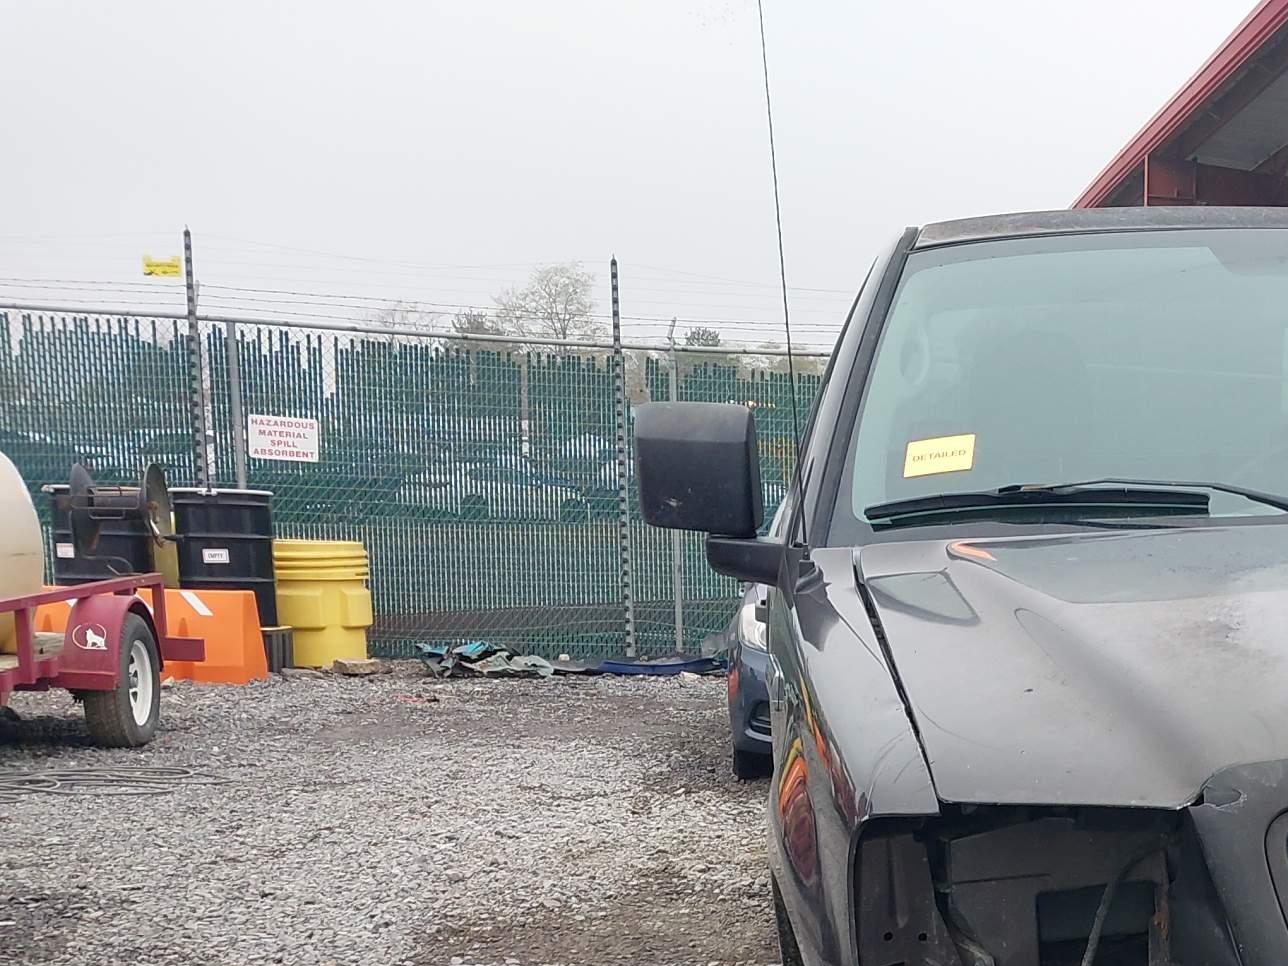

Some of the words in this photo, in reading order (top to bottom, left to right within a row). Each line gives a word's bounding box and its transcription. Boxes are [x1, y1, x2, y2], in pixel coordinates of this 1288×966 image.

[251, 418, 315, 430] HAZARDOUS
[258, 429, 309, 439] MATERIAL
[270, 440, 298, 449] SPILL
[253, 448, 315, 459] ABSORBENT
[912, 449, 967, 463] DETAILED
